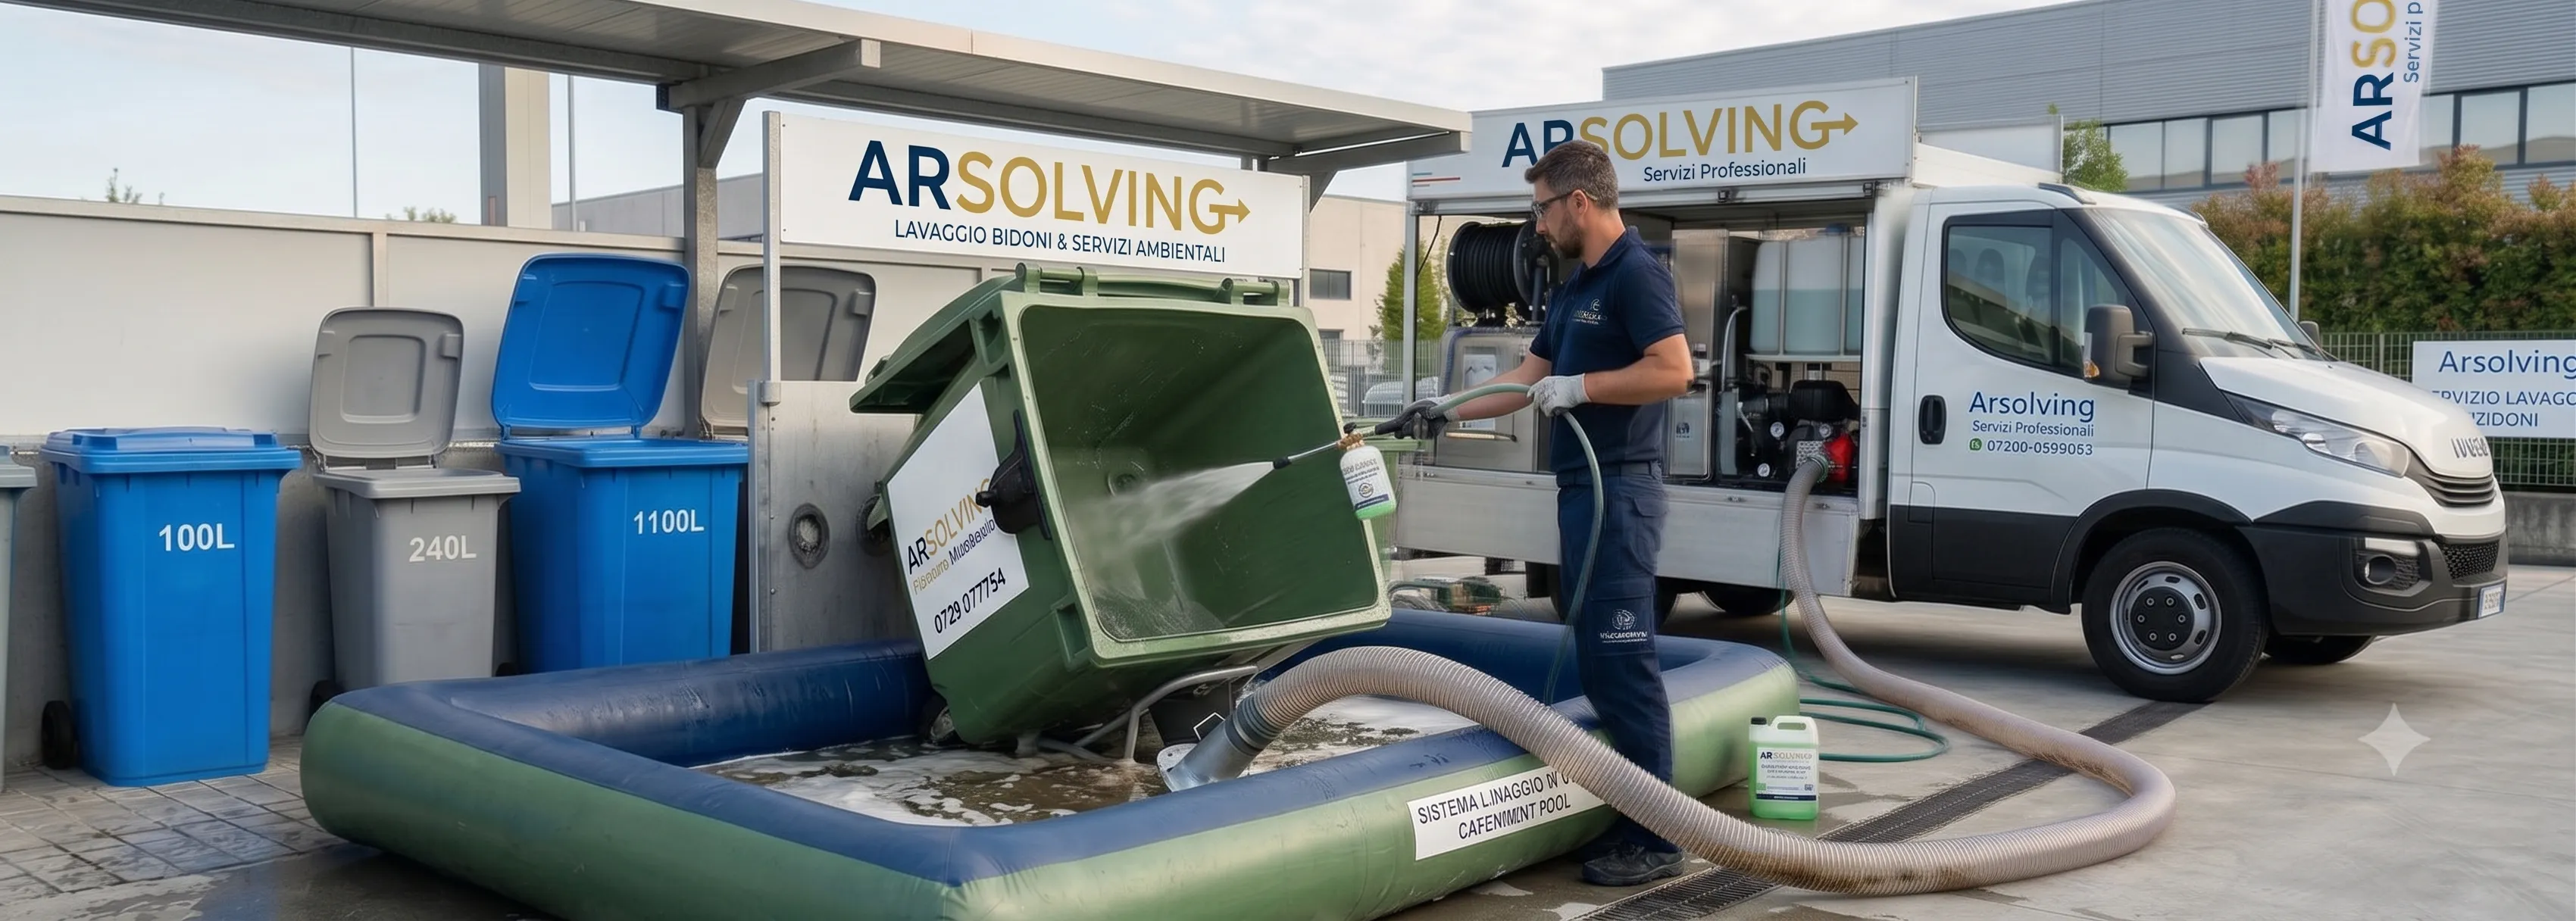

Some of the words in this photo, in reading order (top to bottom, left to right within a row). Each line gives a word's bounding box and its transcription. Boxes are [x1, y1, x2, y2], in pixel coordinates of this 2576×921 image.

[2403, 21, 2422, 83] Servizi
[1643, 164, 1696, 182] Servizi
[1700, 158, 1806, 179] Professionali
[848, 140, 1228, 235] ARSOLVING
[895, 220, 986, 243] LAVAGGIO
[993, 229, 1052, 249] BIDONI
[1057, 233, 1068, 251] &
[1072, 236, 1132, 255] SERVIZI
[1136, 240, 1225, 263] AMBIENTALI
[2438, 349, 2576, 379] Arsolving
[1968, 392, 2095, 423] Arsolving
[2471, 412, 2538, 427] ZIDONI
[1972, 420, 2012, 433] Servizi
[2015, 421, 2094, 437] Professionali
[633, 509, 705, 535] 1100L
[158, 523, 235, 551] 100L
[409, 535, 477, 562] 240L
[934, 601, 961, 634] 0729
[961, 567, 1006, 613] 077754
[1418, 795, 1479, 824] SISTEMA
[1539, 793, 1571, 817] POOL
